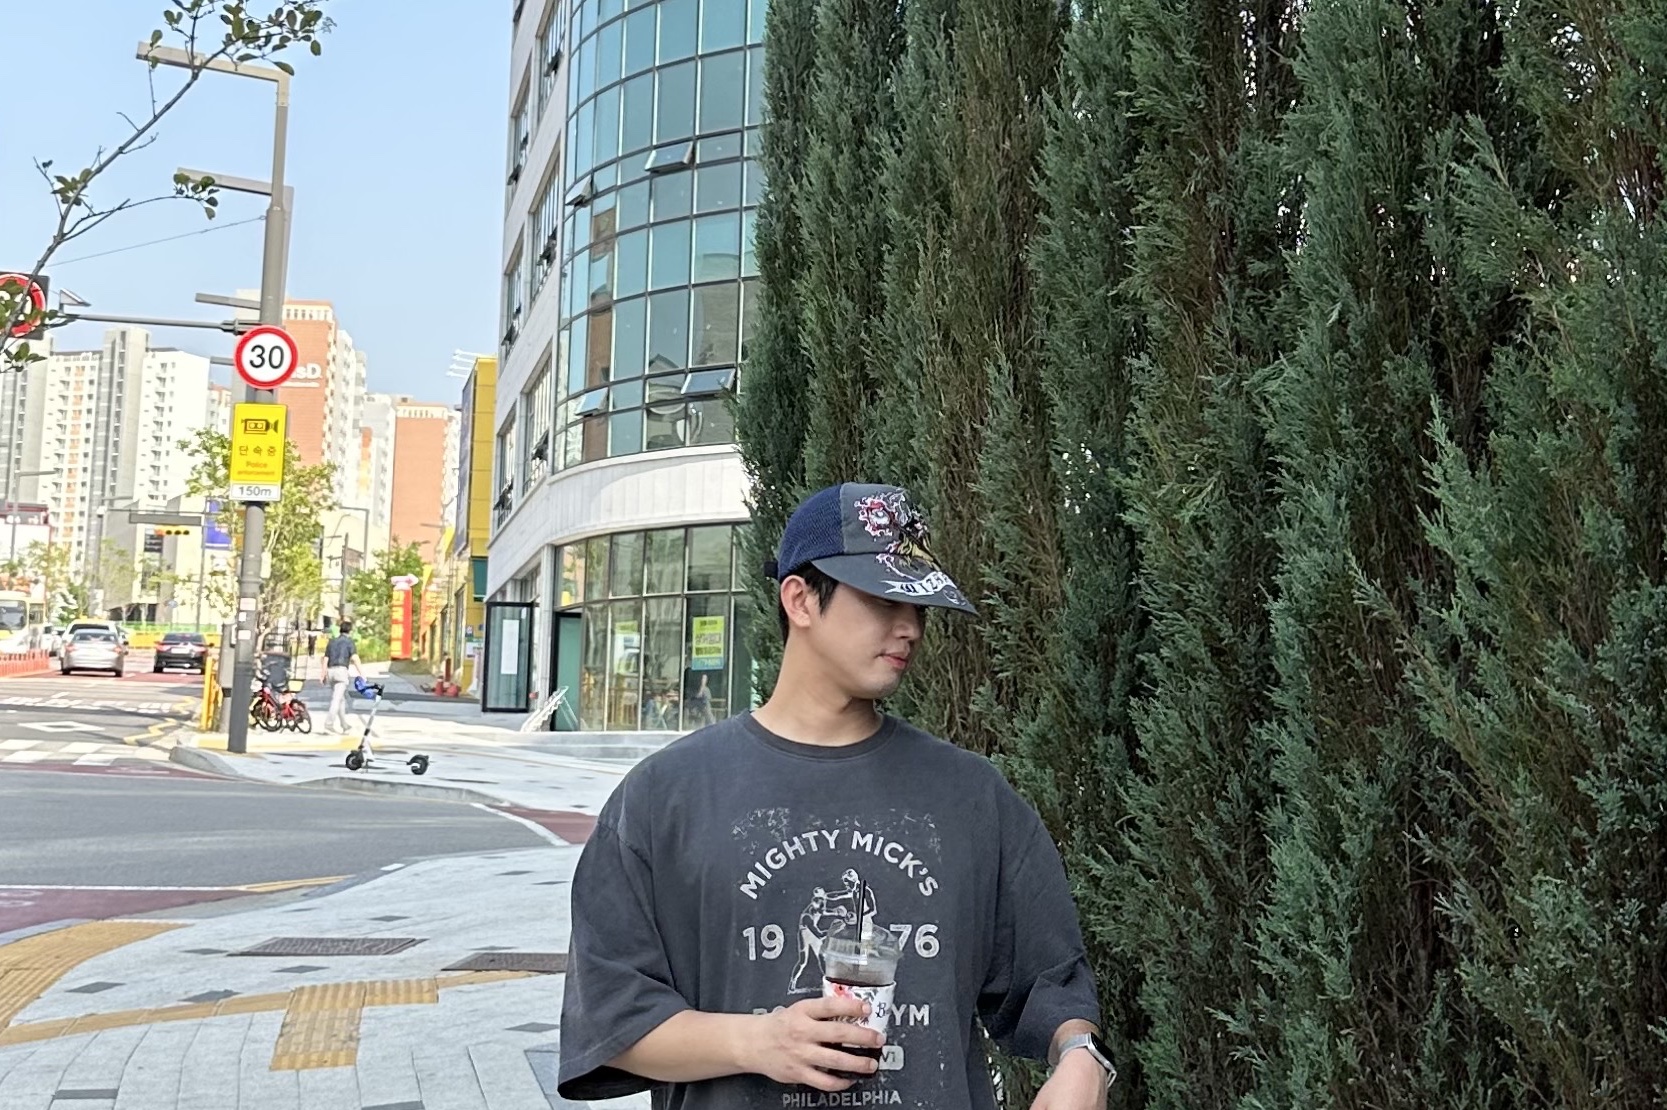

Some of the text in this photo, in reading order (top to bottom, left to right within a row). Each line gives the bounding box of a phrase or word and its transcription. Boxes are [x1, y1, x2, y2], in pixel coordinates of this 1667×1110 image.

[249, 344, 285, 369] 30
[239, 486, 272, 496] 150m
[740, 829, 939, 900] MIGHTY MICK'S
[742, 924, 941, 961] 19 76
[891, 1003, 930, 1027] YM
[782, 1090, 902, 1108] PHILADELPHIA
